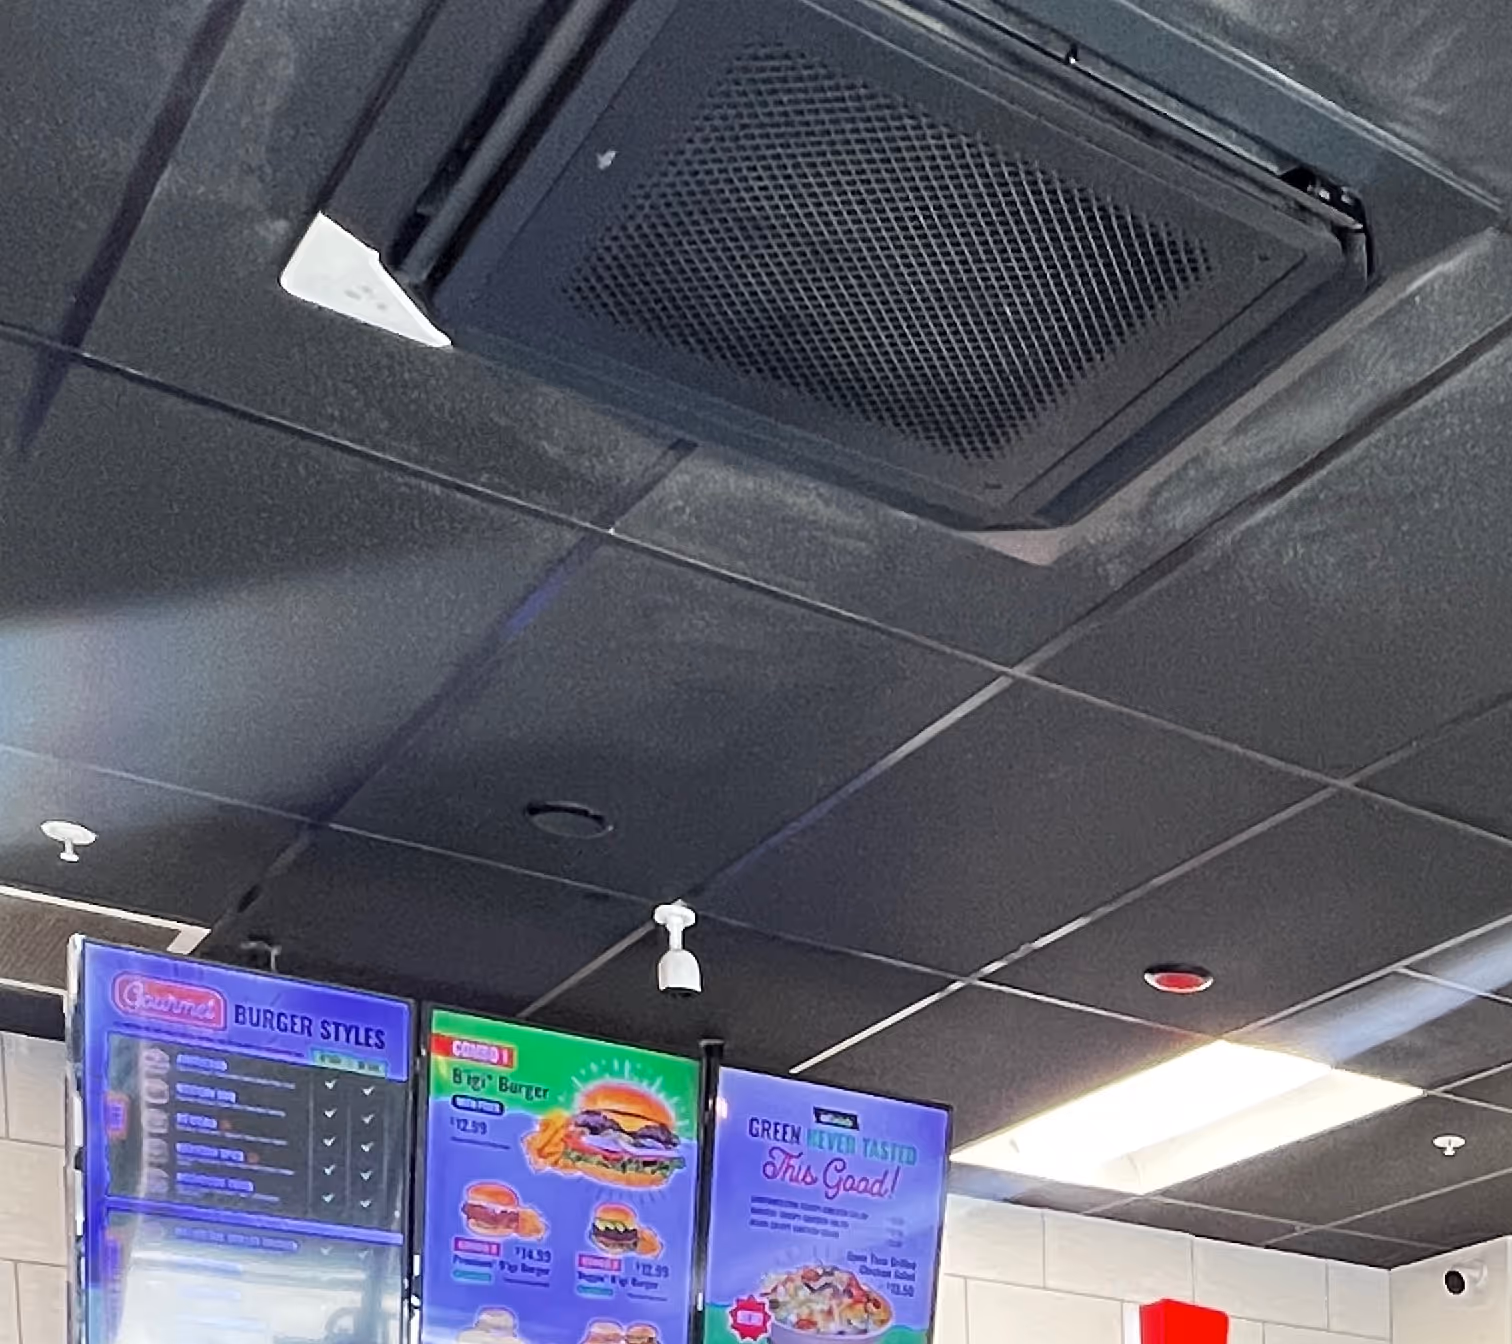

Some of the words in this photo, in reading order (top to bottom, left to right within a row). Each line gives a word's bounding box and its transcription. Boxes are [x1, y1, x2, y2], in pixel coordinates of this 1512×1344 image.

[234, 1004, 313, 1038] BURGER
[319, 1019, 387, 1051] STYLES
[499, 1074, 550, 1101] Burger
[749, 1116, 802, 1145] GREEN
[806, 1127, 857, 1157] NEVER
[861, 1135, 918, 1166] TASTED
[762, 1145, 819, 1187] This
[822, 1156, 902, 1201] Good!
